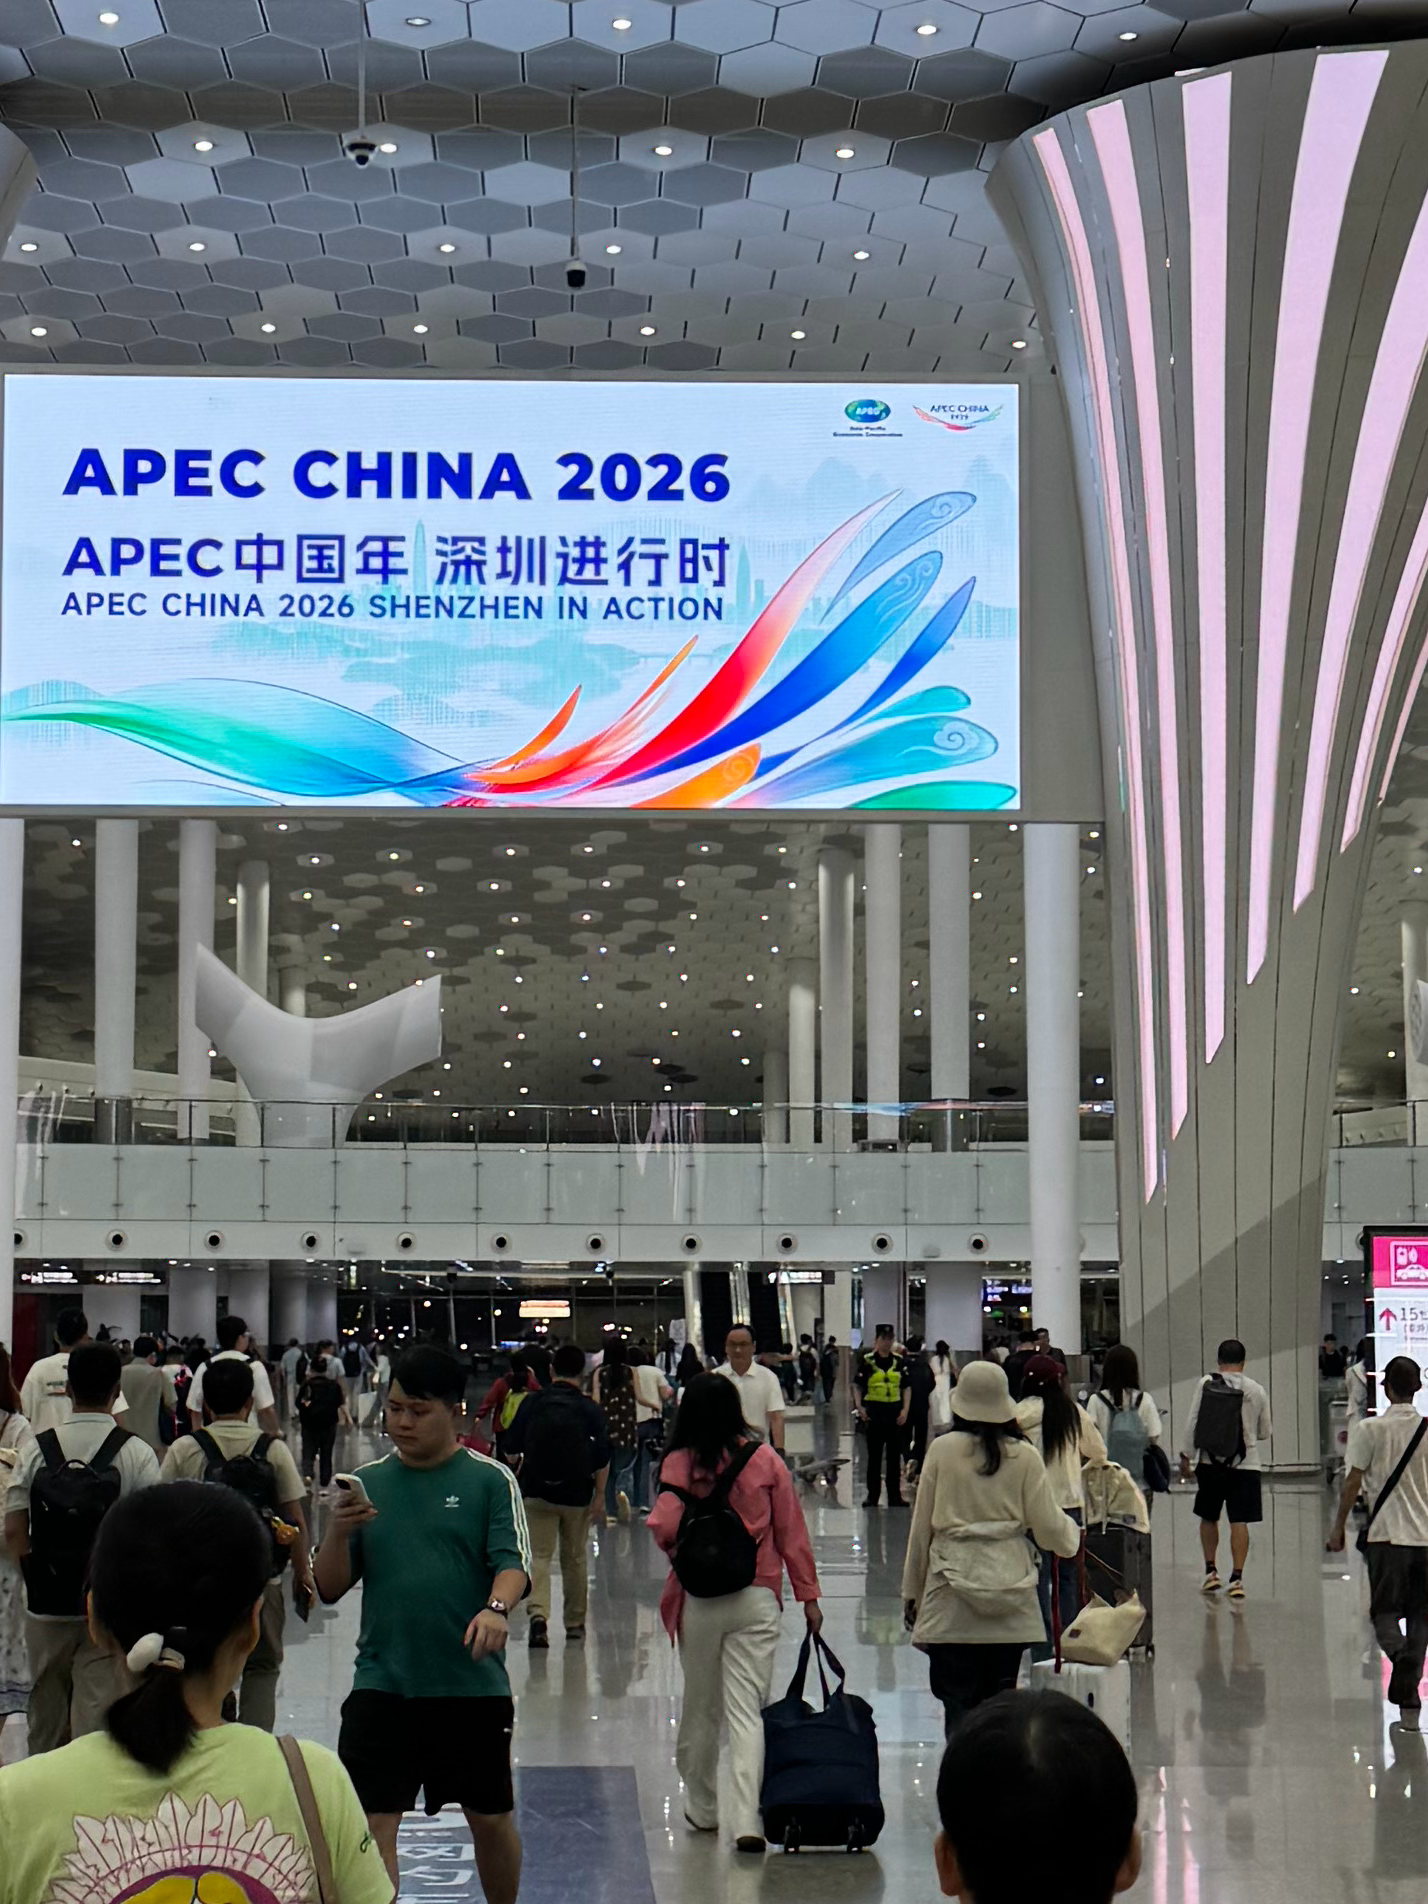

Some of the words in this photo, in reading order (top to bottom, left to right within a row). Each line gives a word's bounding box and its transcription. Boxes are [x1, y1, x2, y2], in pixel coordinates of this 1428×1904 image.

[62, 447, 267, 499] APEC
[293, 449, 533, 500] CHINA
[555, 451, 731, 503] 2026
[61, 532, 409, 586] APEC中国年
[434, 534, 731, 588] 深圳进行时
[61, 591, 148, 617] APEC
[162, 592, 265, 618] CHINA
[278, 594, 356, 619] 2026
[368, 595, 543, 620] SHENZHEN
[558, 596, 588, 620] IN
[602, 596, 724, 621] ACTION
